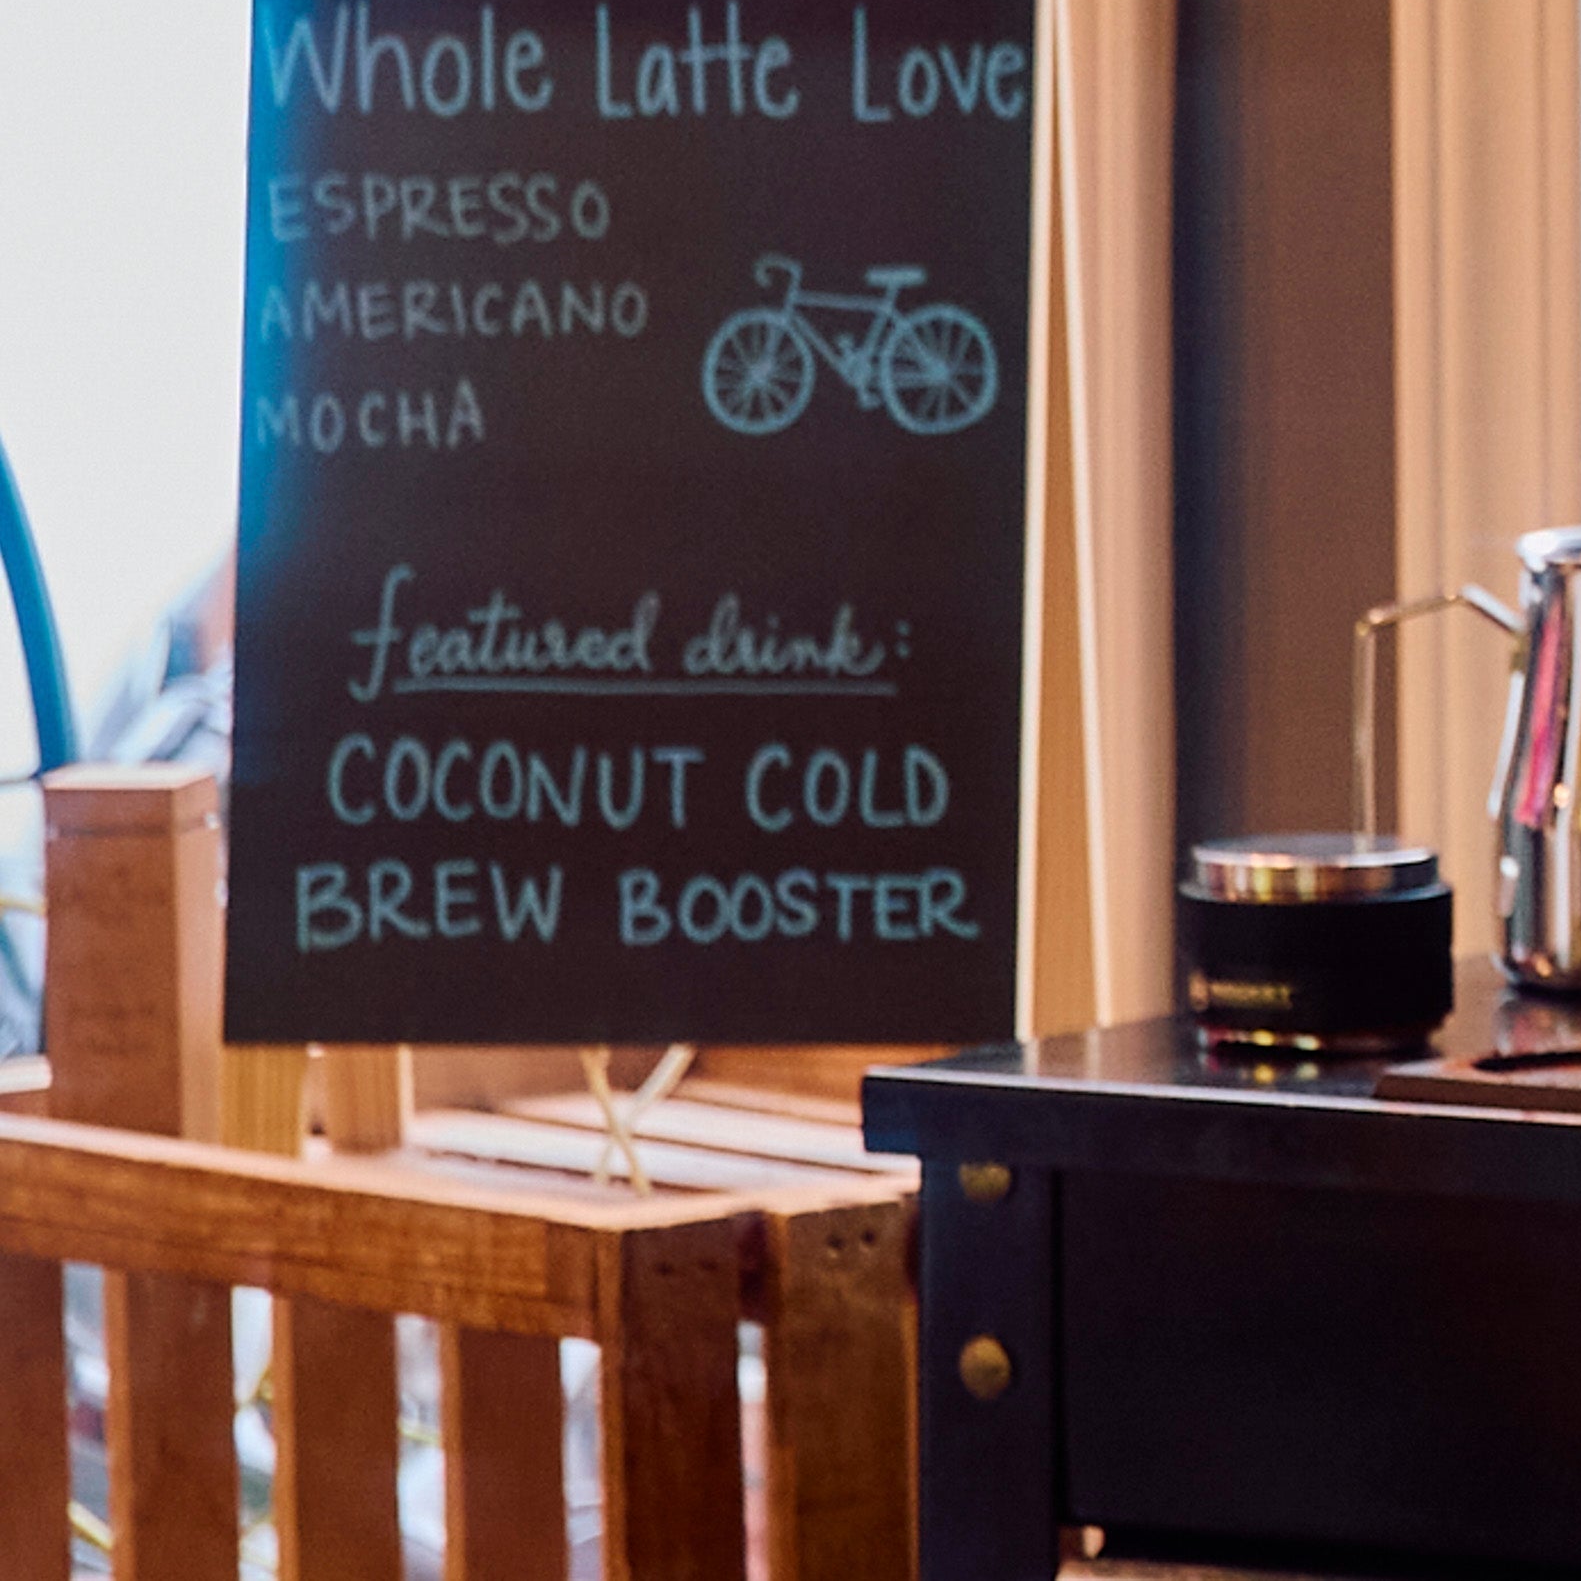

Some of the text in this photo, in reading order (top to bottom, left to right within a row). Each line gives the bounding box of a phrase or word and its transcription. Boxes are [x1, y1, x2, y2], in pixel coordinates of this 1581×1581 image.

[850, 3, 1025, 123] Love
[266, 170, 611, 245] ESPRESSO
[259, 280, 649, 342] AMERICANO
[254, 379, 486, 454] MOCHA
[347, 563, 913, 702] featured drink:
[327, 733, 950, 832] COCONUT COLD
[296, 858, 981, 954] BREW BOOSTER
